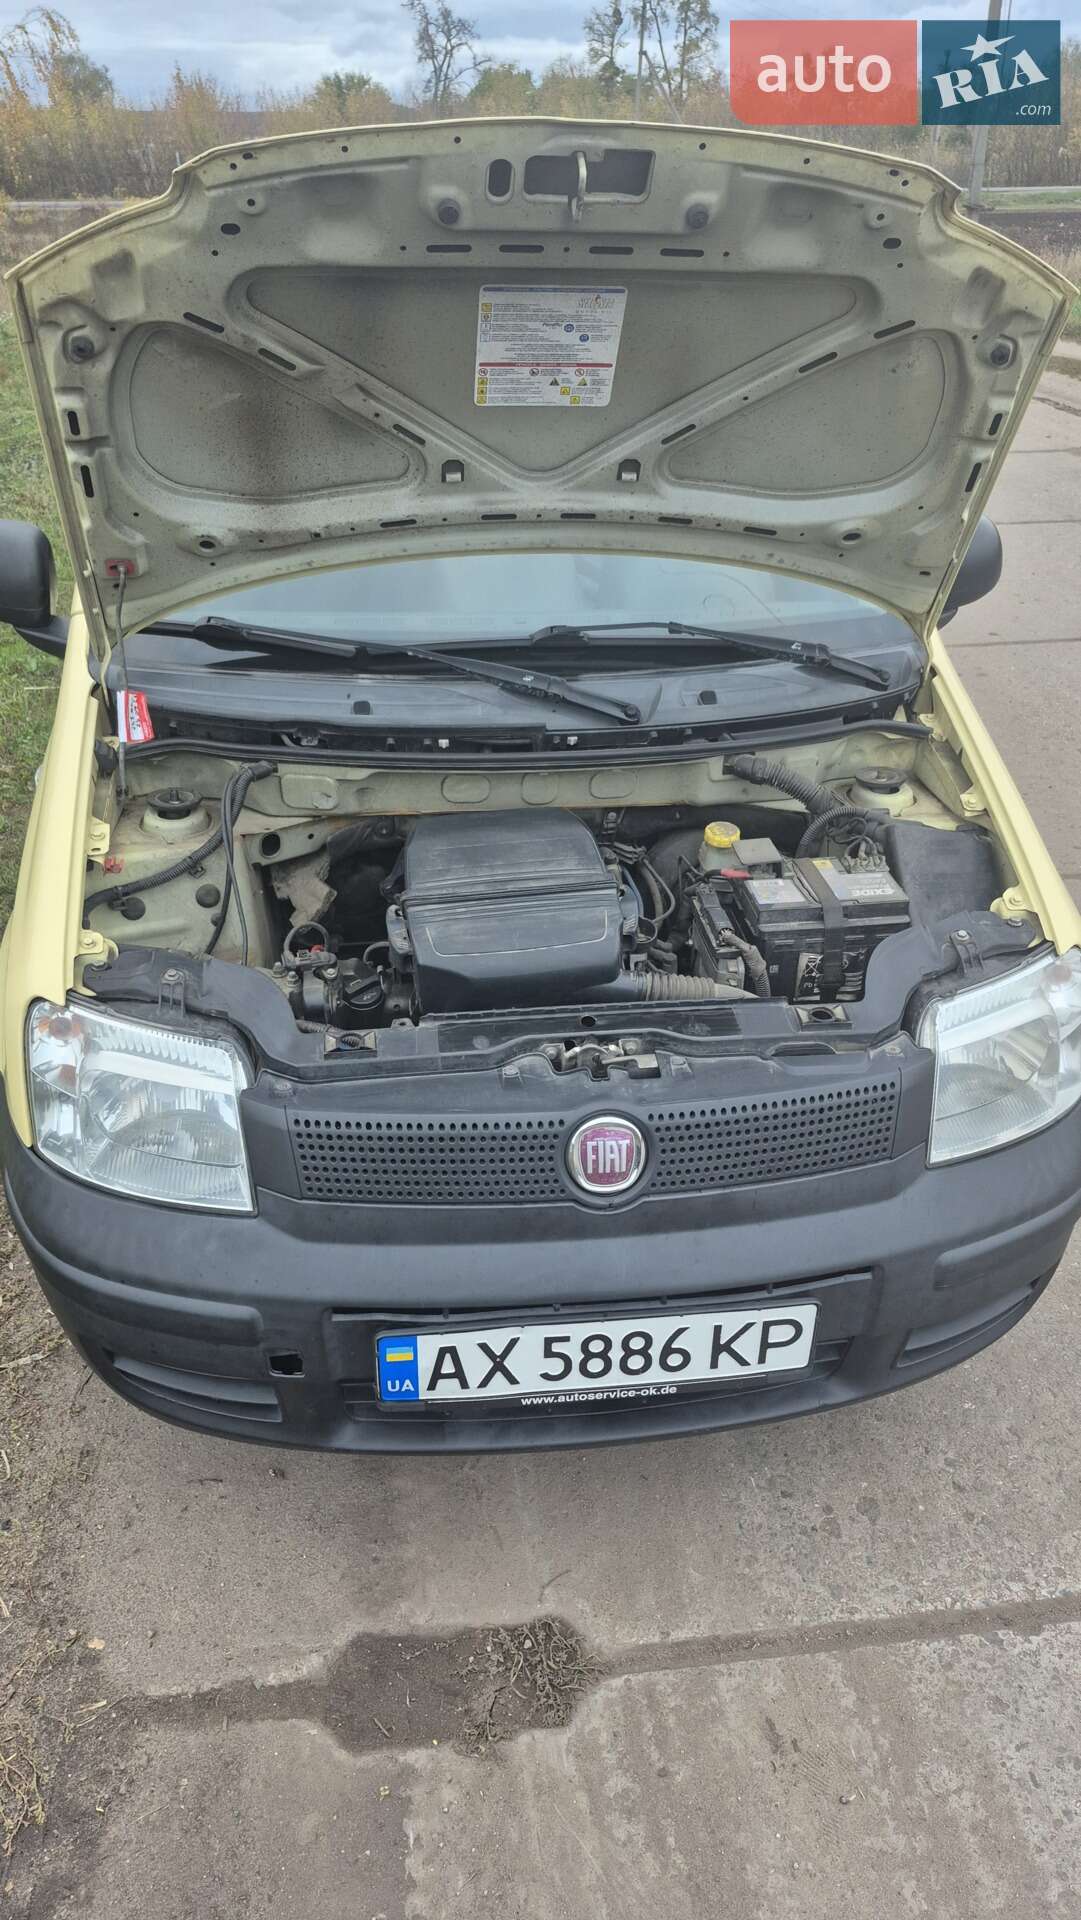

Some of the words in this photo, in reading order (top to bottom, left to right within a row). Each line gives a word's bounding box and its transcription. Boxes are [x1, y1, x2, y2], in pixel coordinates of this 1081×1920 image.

[586, 1139, 631, 1174] FIAT
[426, 1337, 520, 1392] AX
[539, 1327, 692, 1382] 5886
[709, 1318, 803, 1369] KP
[387, 1379, 415, 1392] UA
[520, 1385, 678, 1405] www.autoservice-ok.de
